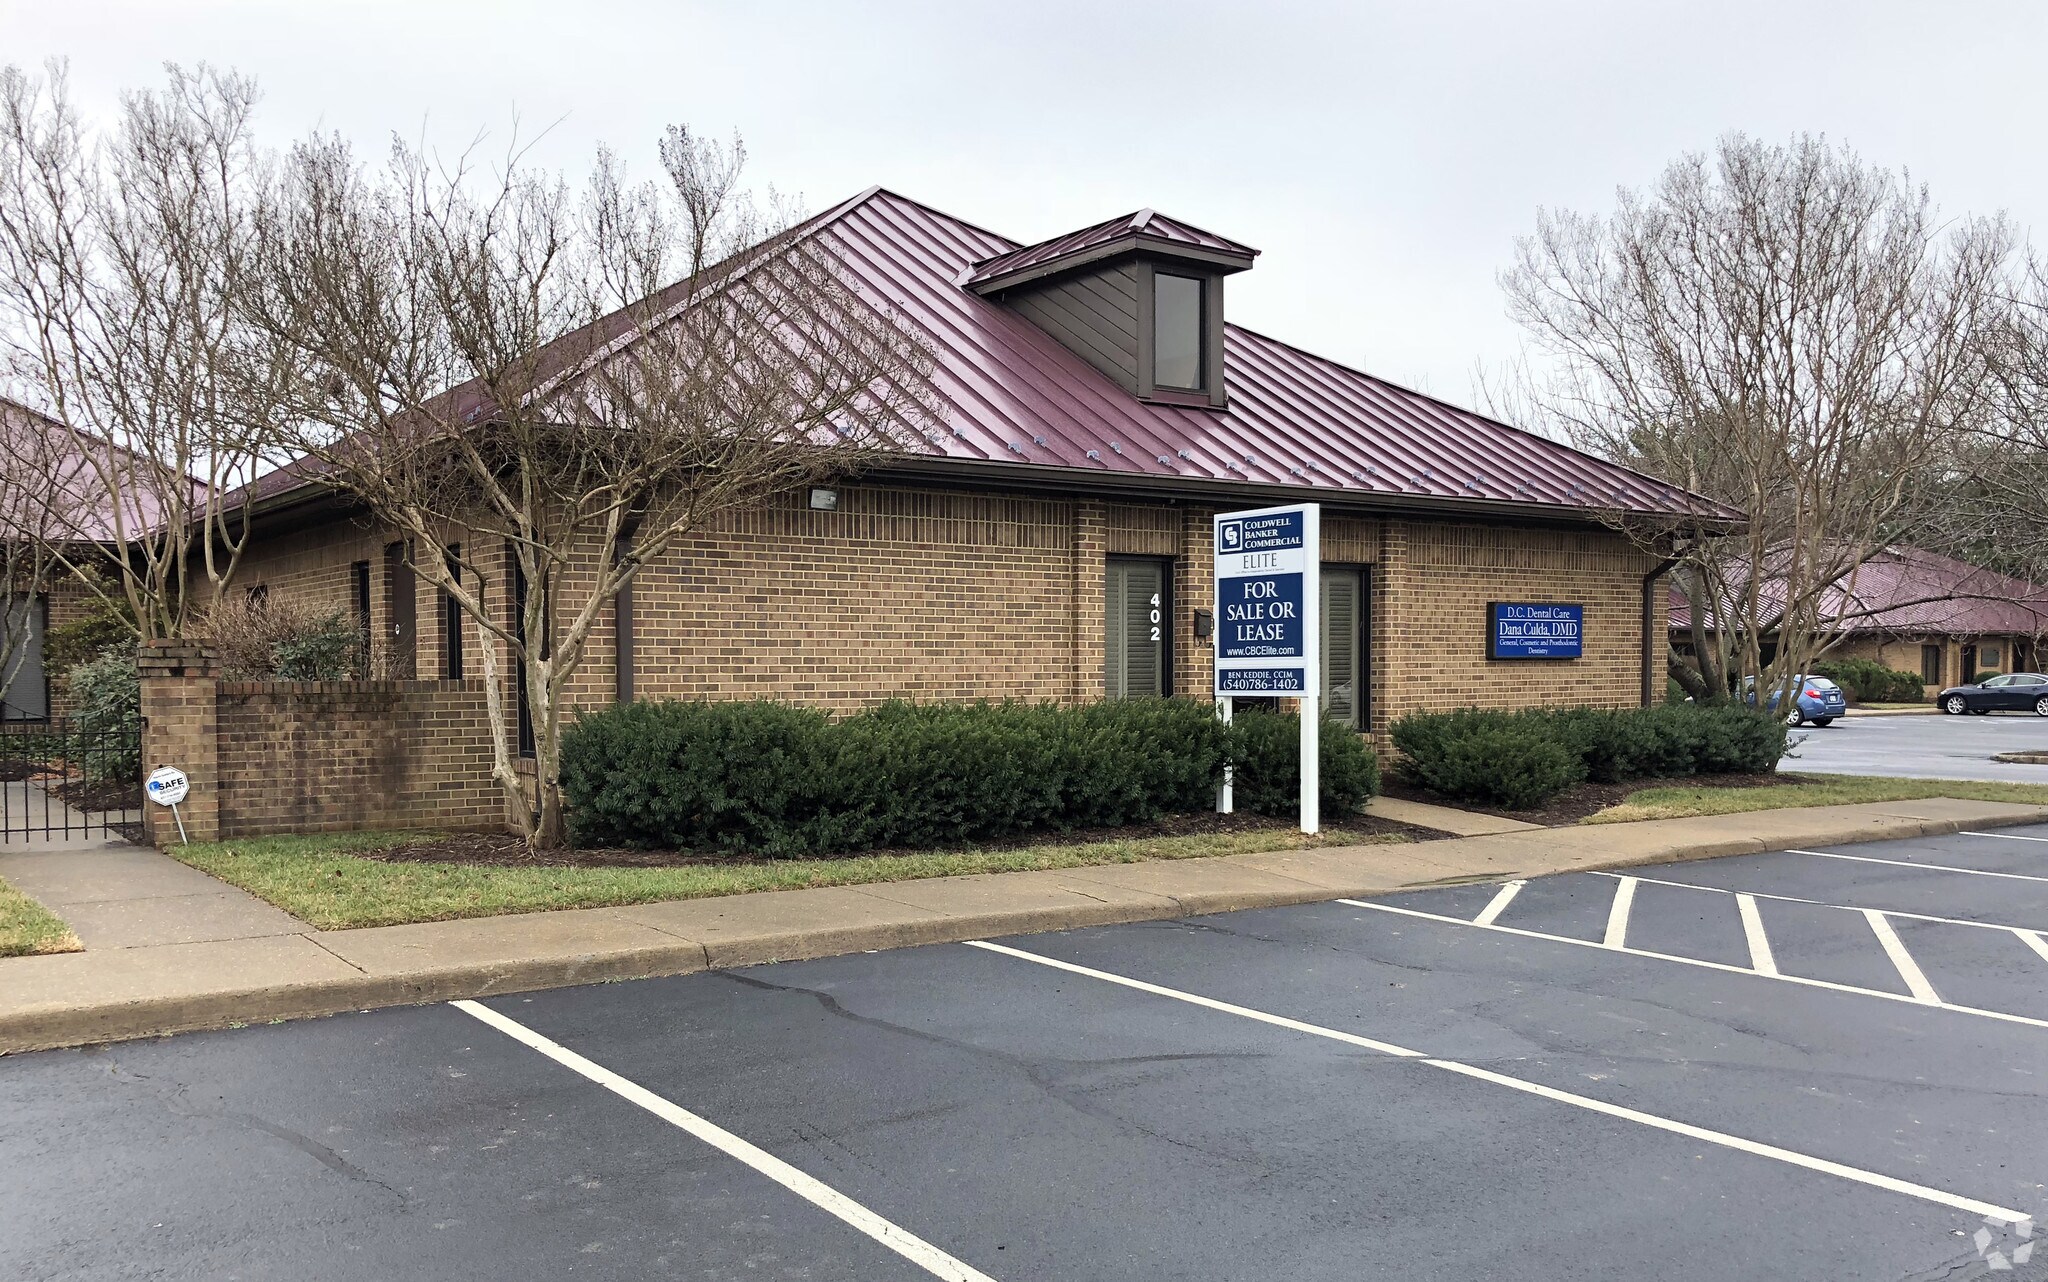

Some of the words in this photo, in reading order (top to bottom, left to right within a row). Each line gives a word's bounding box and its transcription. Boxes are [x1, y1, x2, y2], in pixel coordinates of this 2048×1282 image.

[1244, 518, 1291, 530] COLDWELL
[1244, 529, 1278, 539] BANKER
[1244, 536, 1301, 549] COMMERCIAL
[1243, 552, 1277, 569] ELITE
[1243, 581, 1278, 599] FOR
[1150, 593, 1160, 641] 402
[1226, 603, 1264, 621] SALE
[1268, 601, 1296, 619] OR
[1507, 606, 1525, 618] D.C.
[1527, 607, 1552, 619] Dental
[1553, 607, 1571, 619] Care
[1236, 623, 1284, 641] LEASE
[1499, 621, 1522, 635] Dana
[1552, 622, 1578, 636] DMD
[1226, 646, 1295, 656] www.CBCElite.com
[1528, 647, 1548, 655] Dentistry
[1227, 671, 1241, 679] BEN
[1273, 670, 1293, 679] CCIM
[1223, 678, 1298, 691] (540)786-1402
